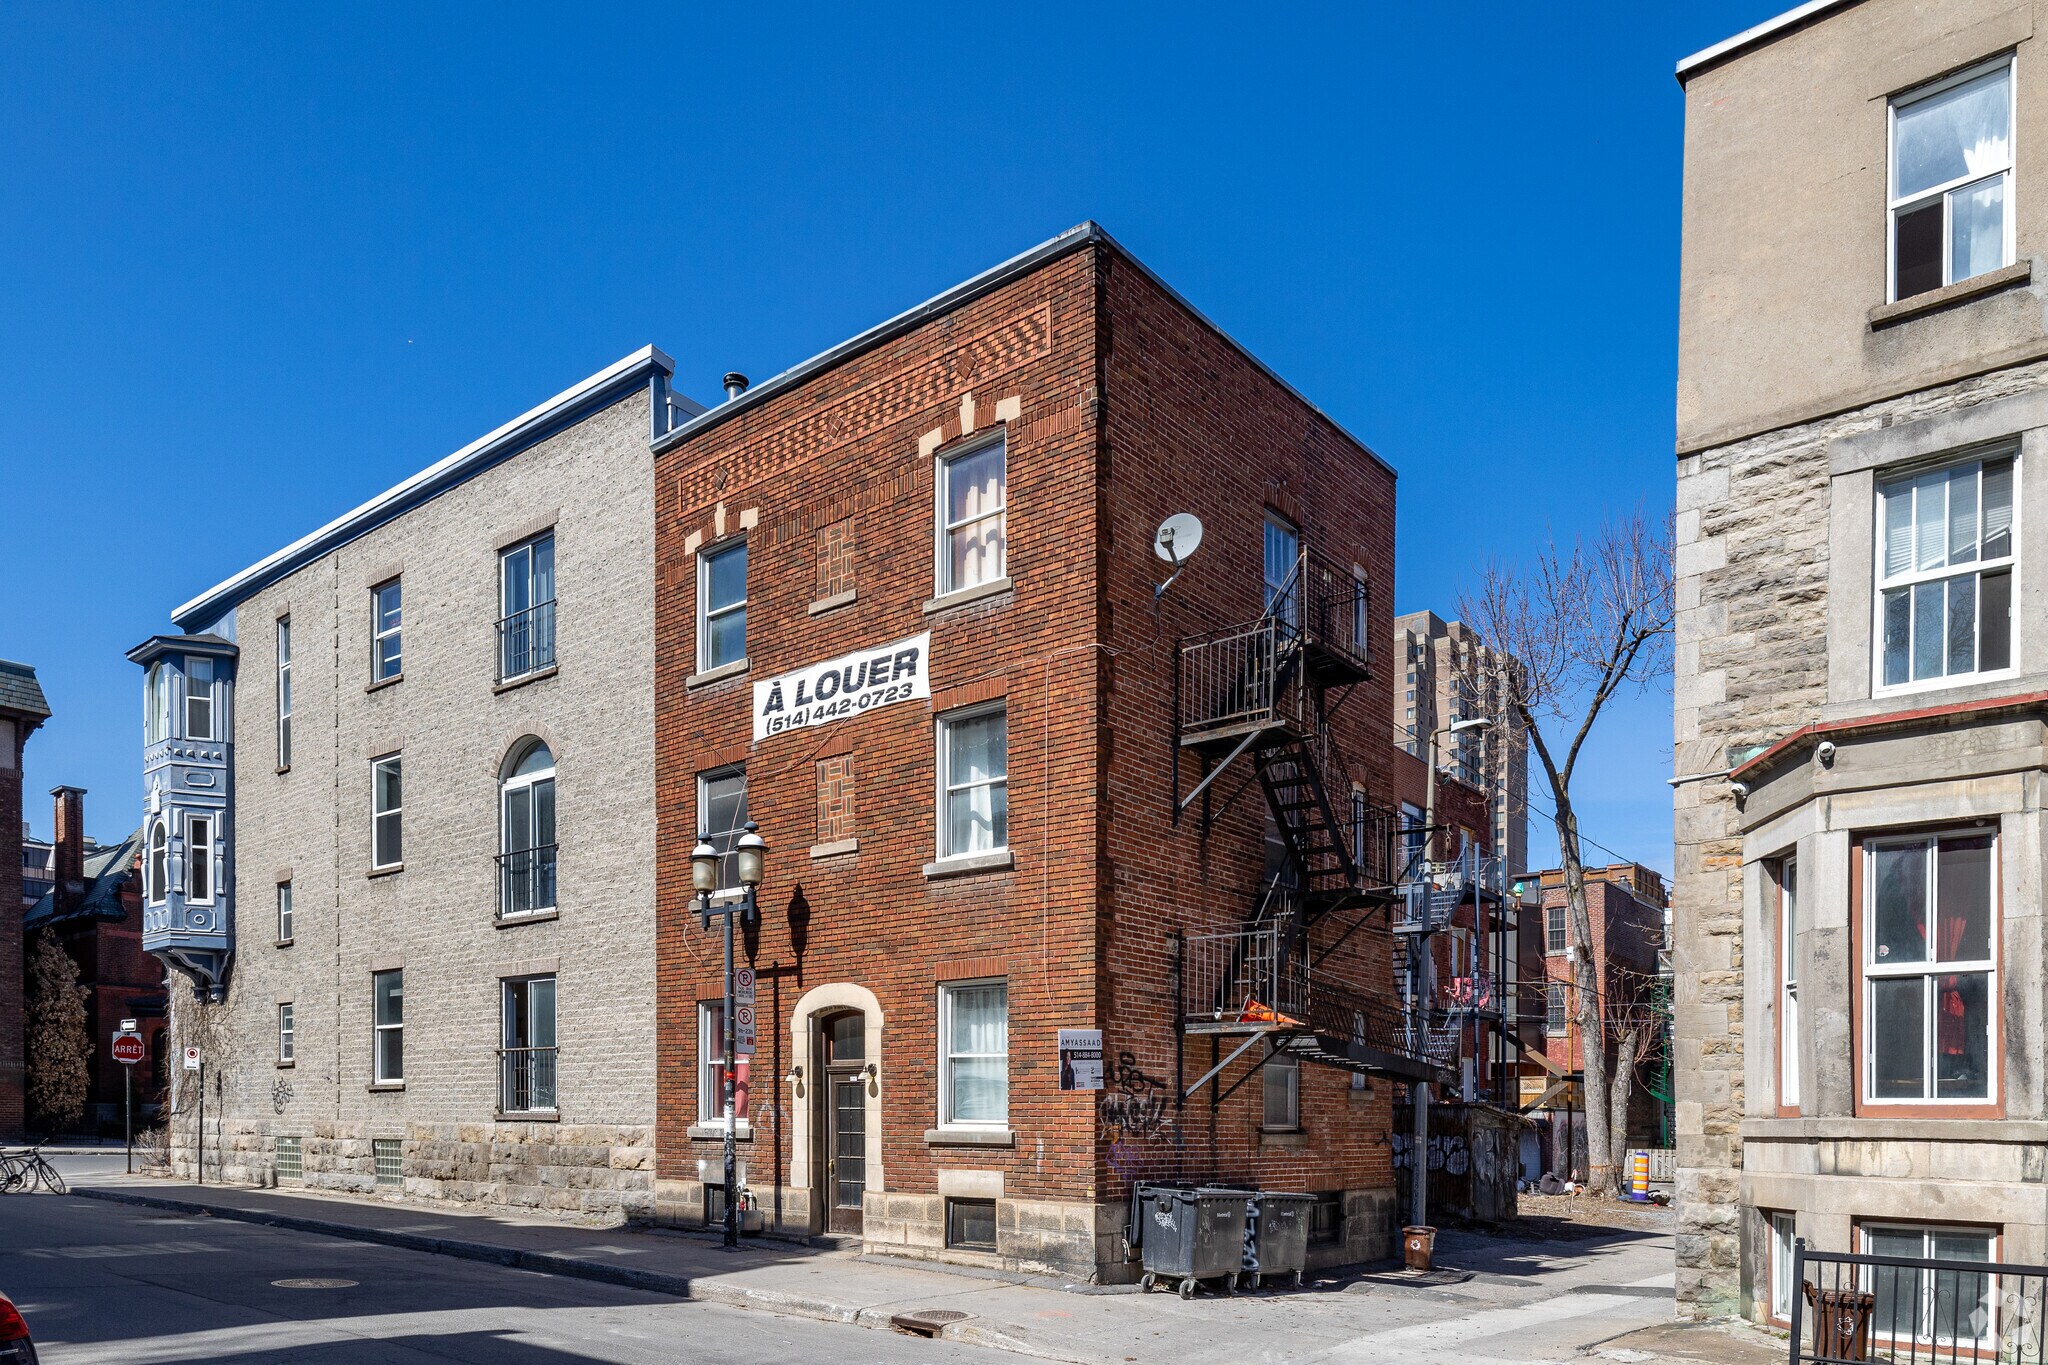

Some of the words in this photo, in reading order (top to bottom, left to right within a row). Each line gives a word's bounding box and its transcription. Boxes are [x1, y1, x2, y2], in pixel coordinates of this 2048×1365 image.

[762, 681, 784, 716] À
[795, 648, 919, 708] LOUER
[766, 708, 810, 735] (514)
[813, 682, 913, 719] 442-0723
[114, 1044, 143, 1054] ARRÊT
